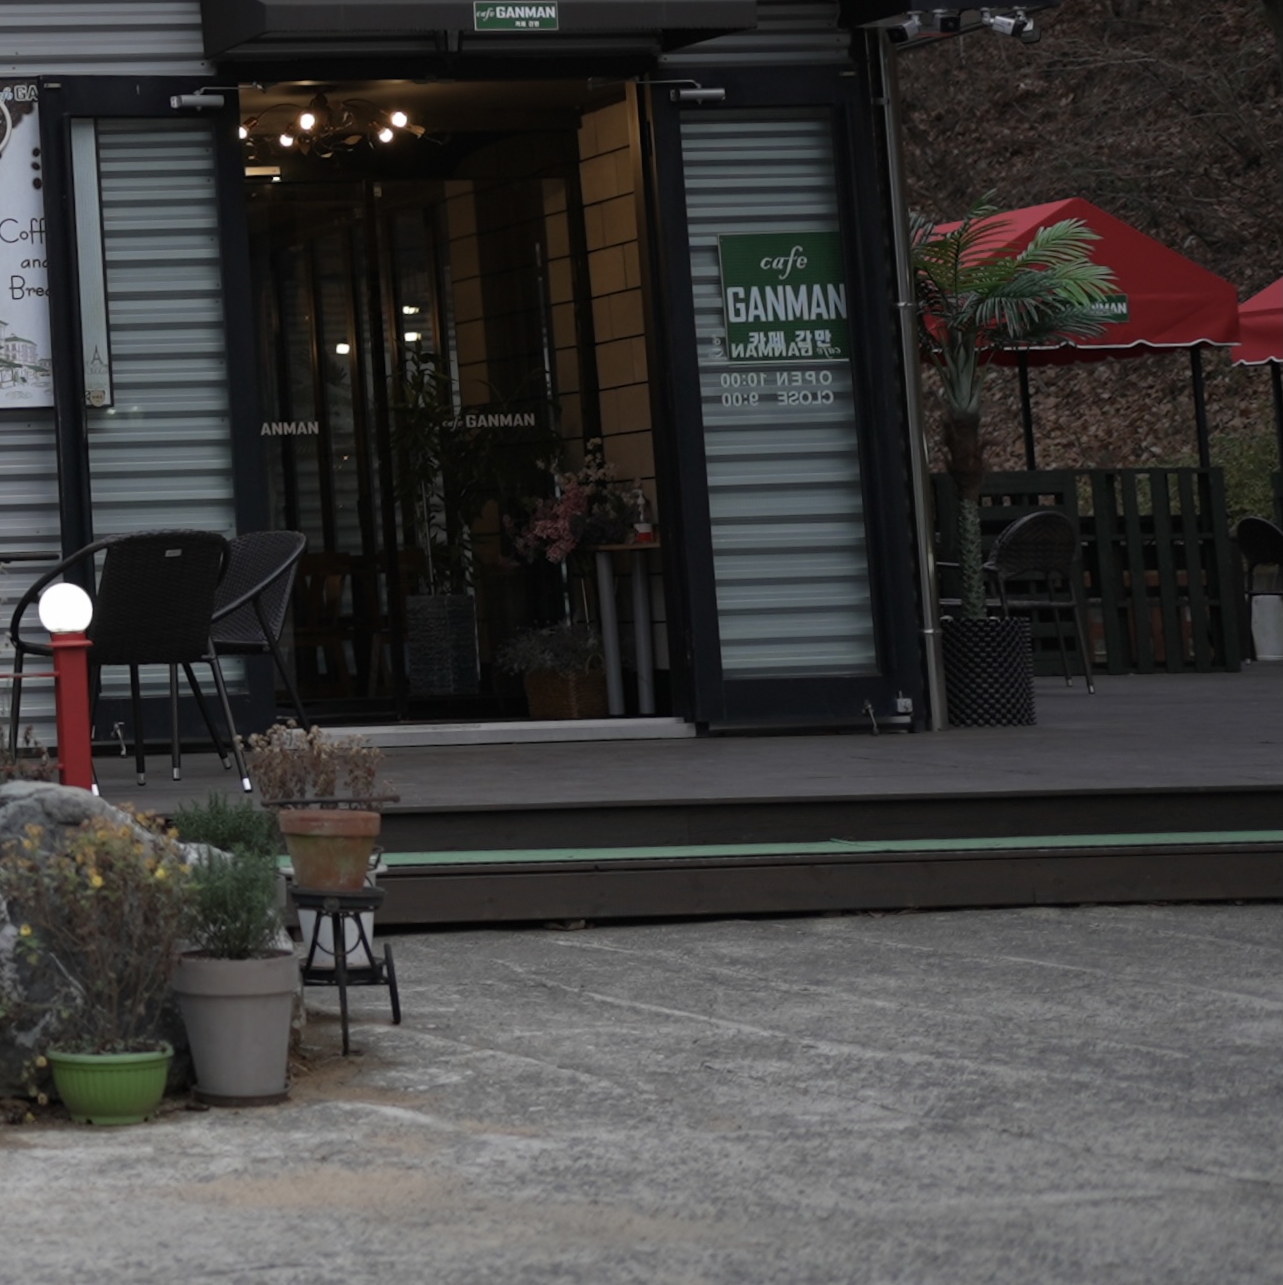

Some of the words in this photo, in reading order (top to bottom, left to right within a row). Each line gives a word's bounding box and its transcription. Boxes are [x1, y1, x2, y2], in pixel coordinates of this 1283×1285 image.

[476, 7, 495, 22] cafe
[495, 6, 556, 19] GANMAN
[760, 245, 808, 280] cafe
[8, 275, 51, 301] Bre
[726, 283, 847, 323] GANMAN
[260, 421, 319, 436] ANMAN
[442, 416, 464, 432] cafe
[465, 412, 536, 428] GANMAN
